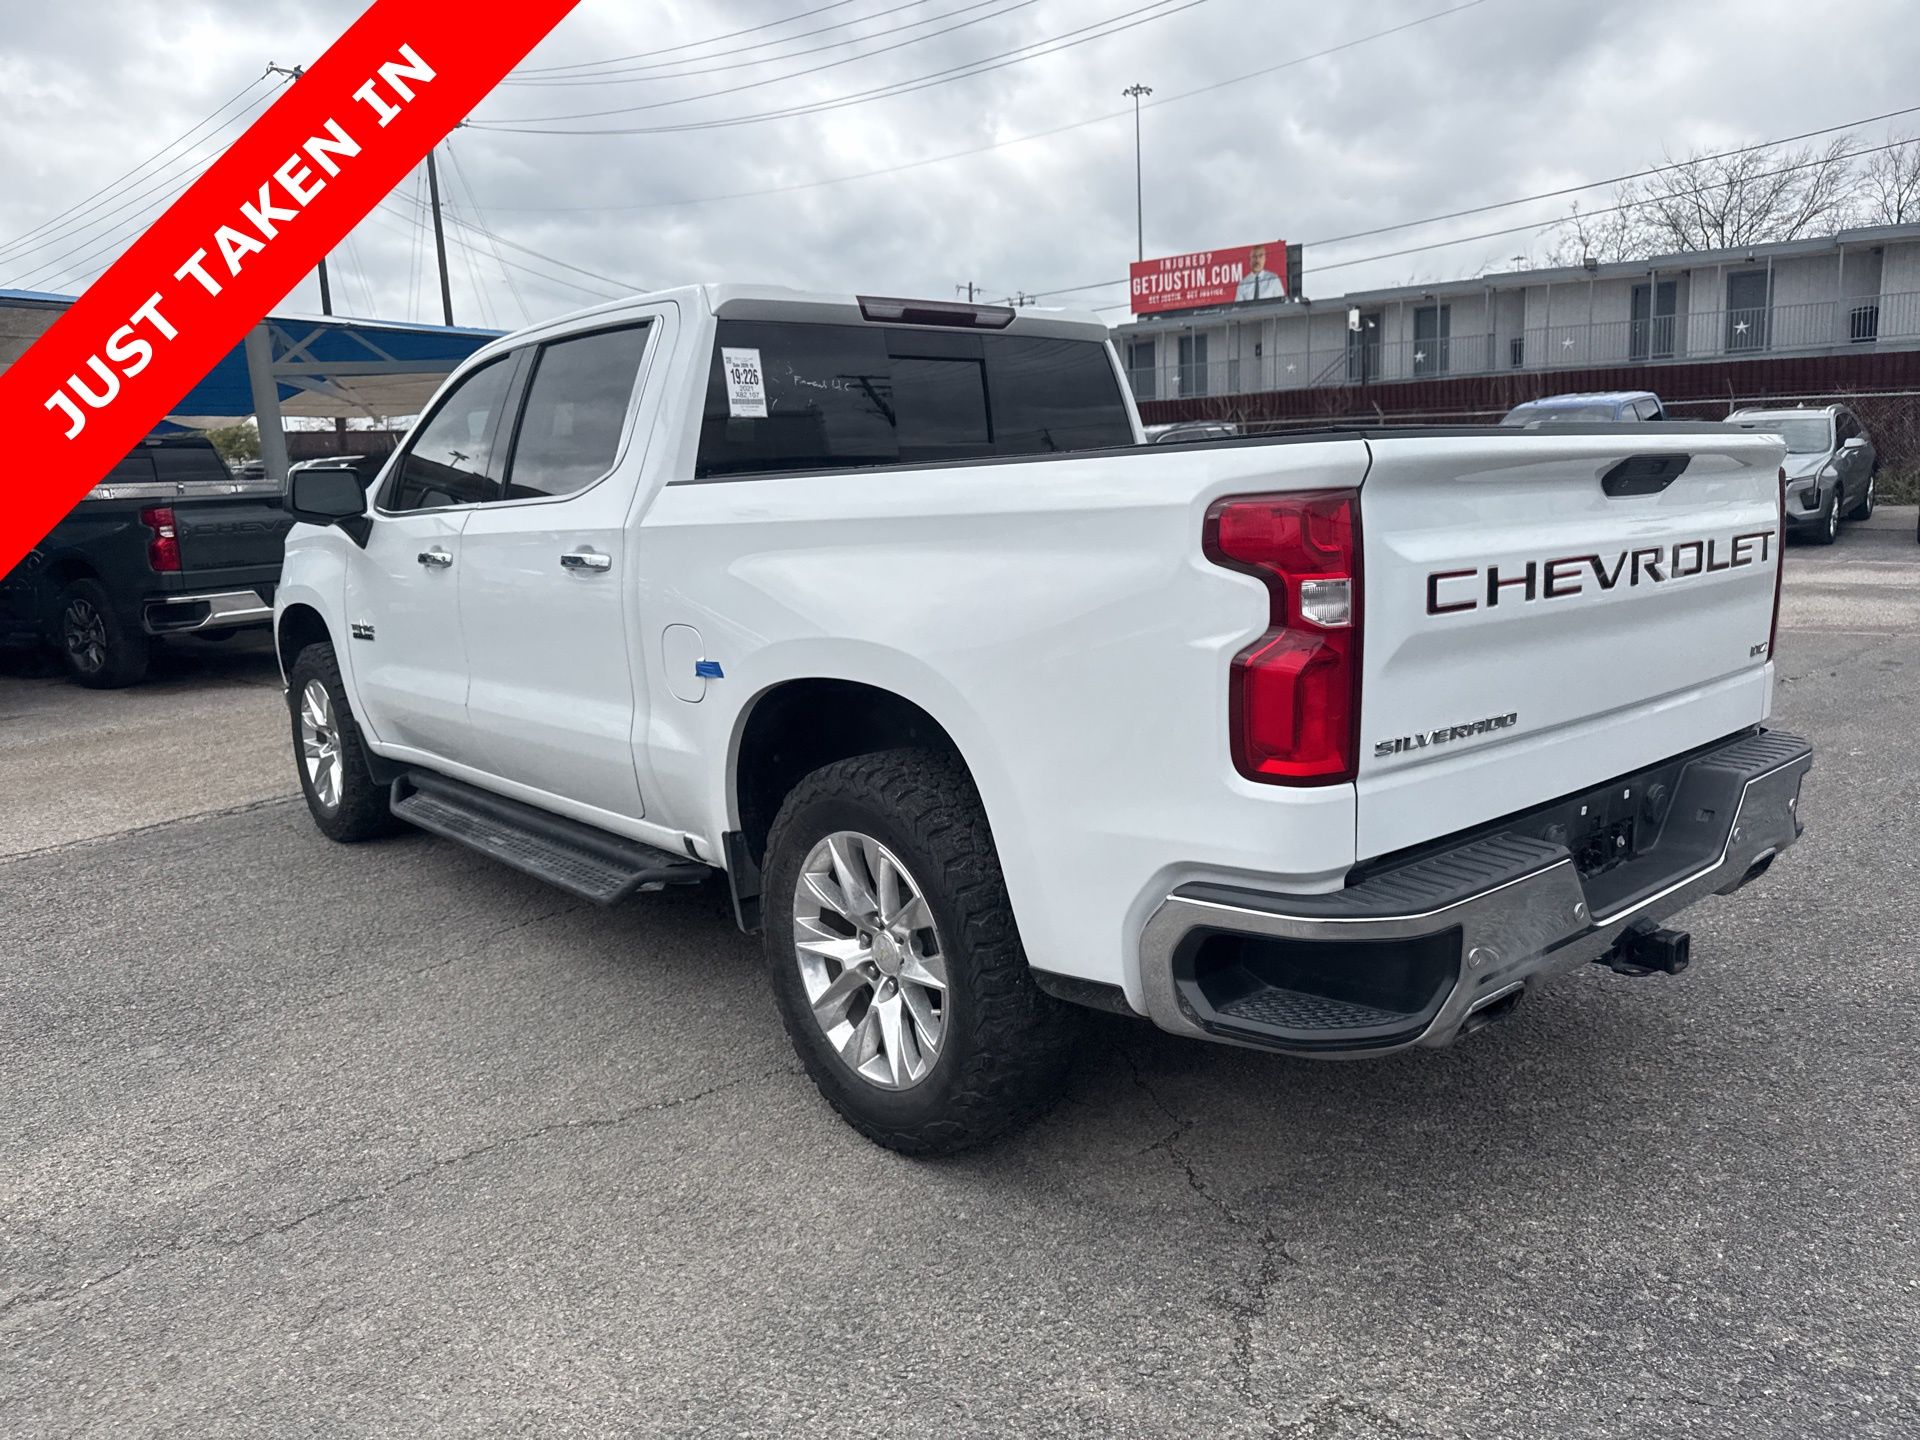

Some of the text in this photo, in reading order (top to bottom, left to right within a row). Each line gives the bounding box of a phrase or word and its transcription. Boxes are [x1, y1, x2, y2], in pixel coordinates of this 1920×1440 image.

[1160, 252, 1213, 271] INJURED?
[1132, 262, 1243, 296] GETJUSTIN.COM
[730, 368, 759, 385] 19:226
[1426, 531, 1775, 616] CHEVROLET
[1374, 712, 1517, 757] SILVERADO
